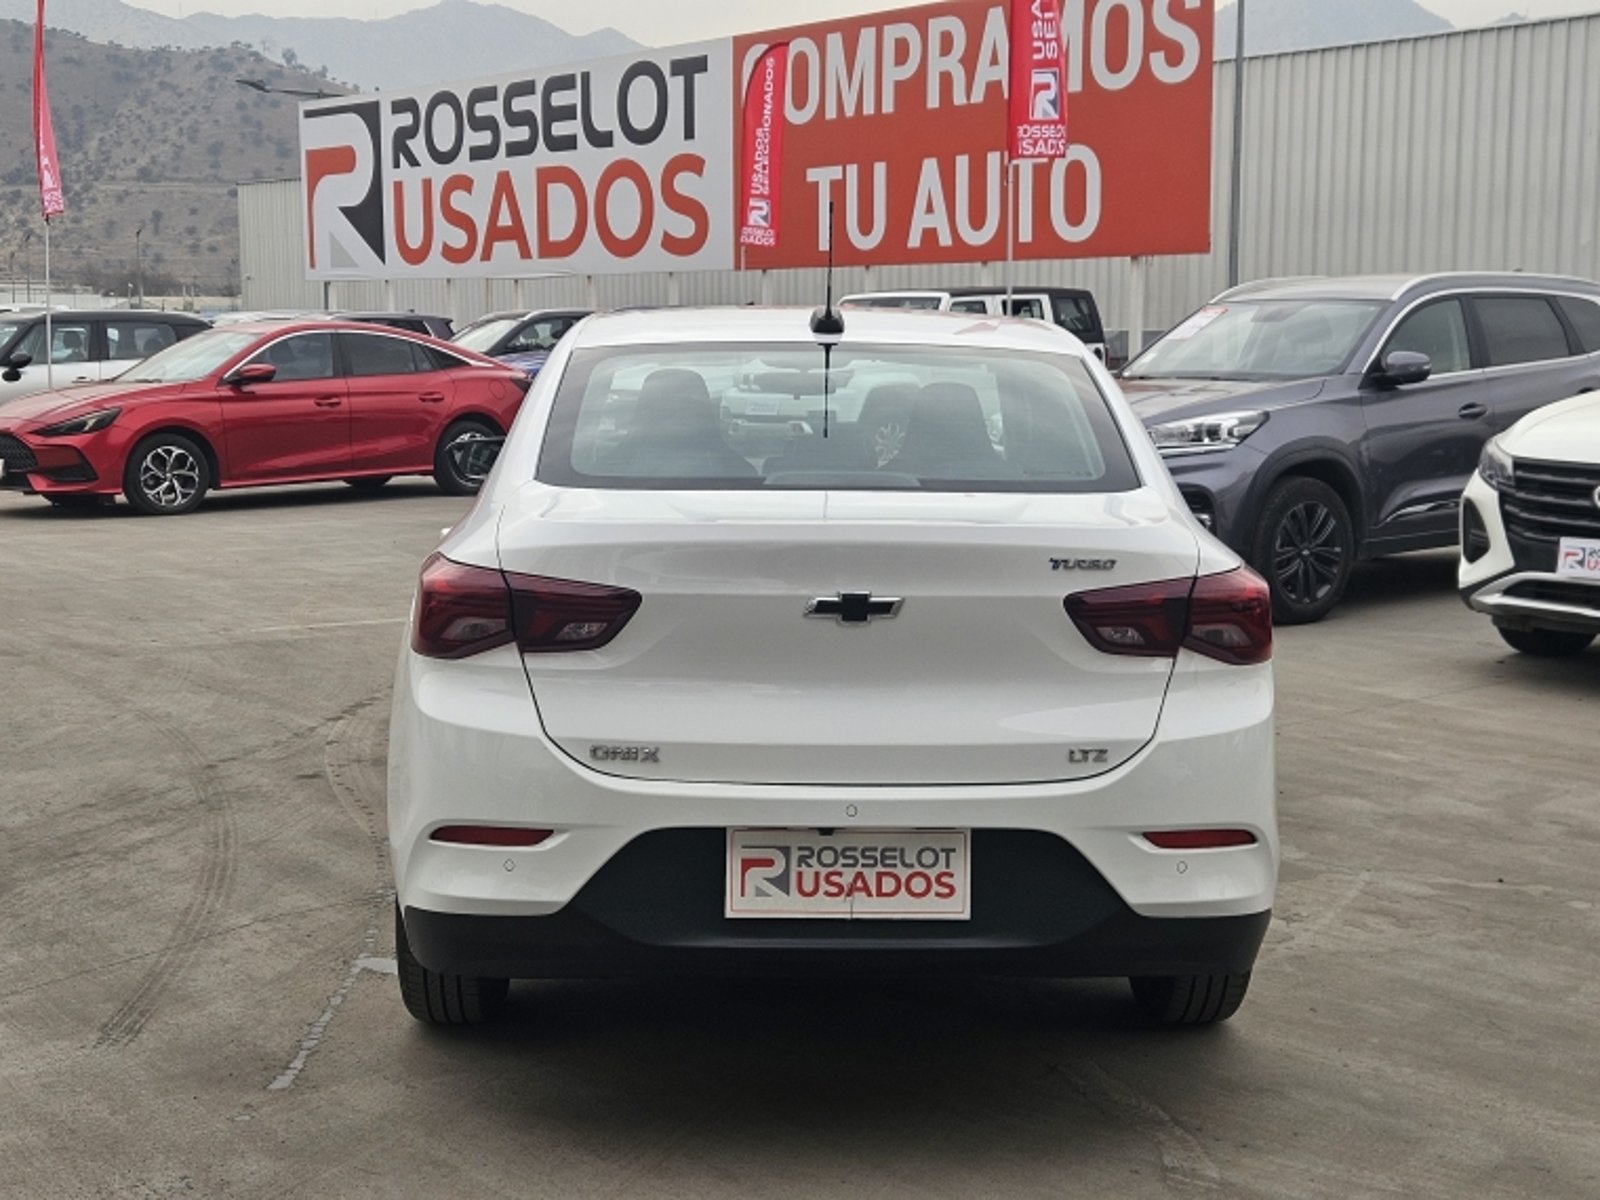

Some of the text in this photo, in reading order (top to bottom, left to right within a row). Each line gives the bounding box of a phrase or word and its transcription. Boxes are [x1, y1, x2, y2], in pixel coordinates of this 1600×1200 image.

[391, 55, 708, 169] ROSSELOT
[393, 153, 710, 266] USADOS
[806, 144, 1101, 251] TU AUTO
[1069, 749, 1108, 763] LTZ
[796, 846, 957, 869] ROSSELOT
[796, 870, 957, 898] USADOS
